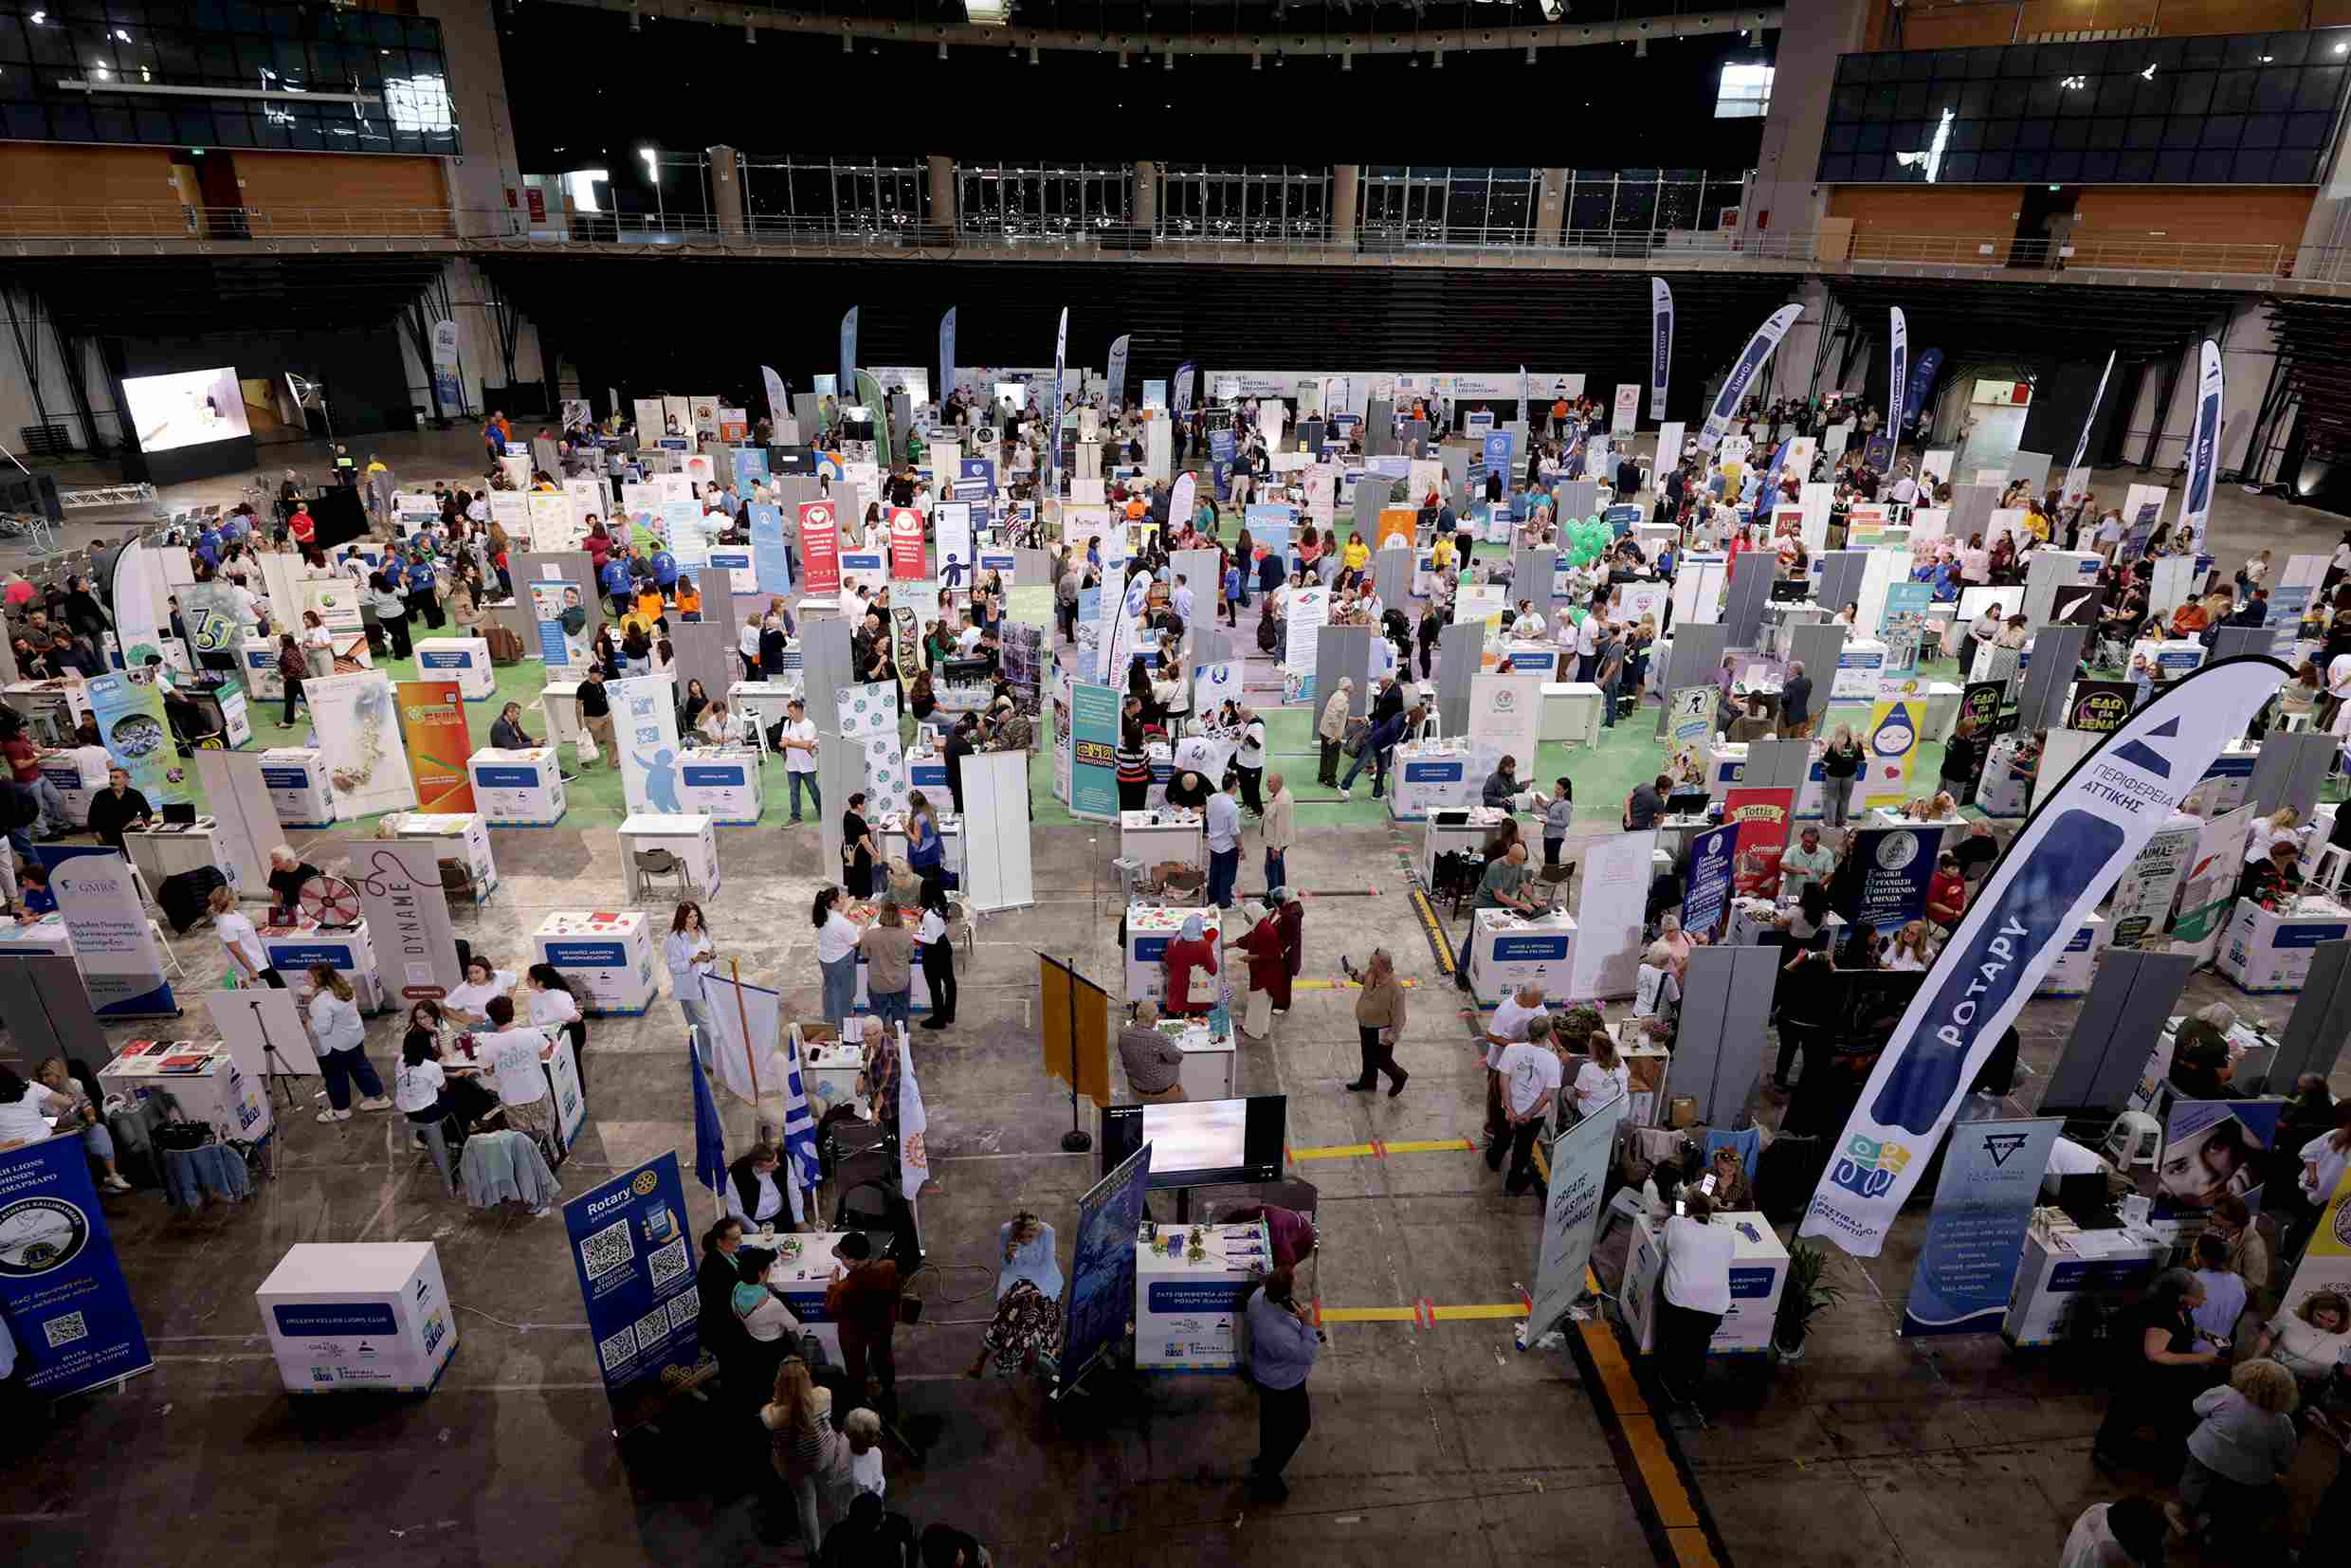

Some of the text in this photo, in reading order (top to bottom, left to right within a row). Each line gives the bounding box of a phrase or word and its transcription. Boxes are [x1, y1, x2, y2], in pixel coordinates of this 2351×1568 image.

[2091, 698, 2123, 710] ΕΔΩ
[2080, 779, 2144, 813] ΑΤΤΙΚΗΣ
[2093, 763, 2176, 809] ΠΕΡΙΦΕΡΕΙΑ
[1743, 805, 1775, 816] Tottis
[390, 883, 425, 954] DYNAME
[1937, 912, 2031, 1048] ΡΟΤΑΡΥ
[12, 1158, 46, 1173] LIONS
[587, 1186, 631, 1216] Rotary
[1555, 1173, 1589, 1210] CREATE
[1558, 1184, 1597, 1223] LASTING
